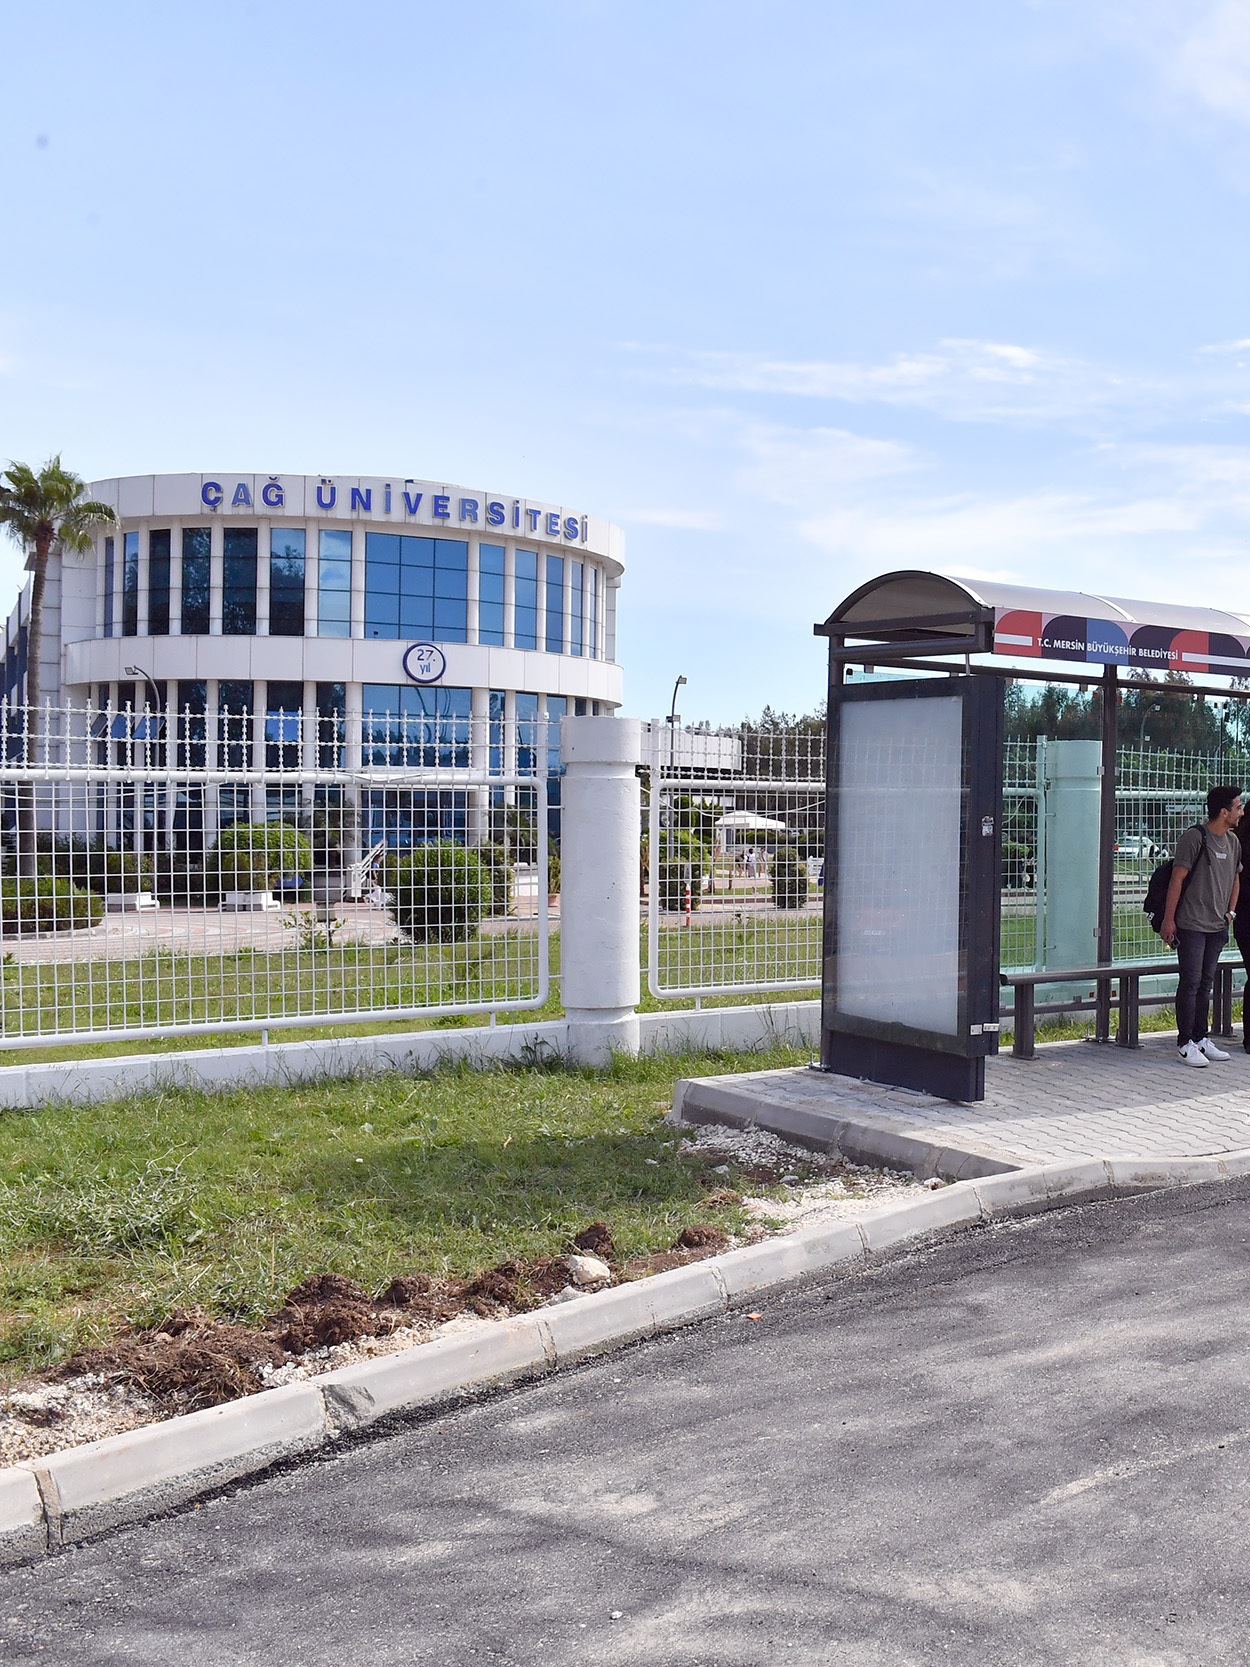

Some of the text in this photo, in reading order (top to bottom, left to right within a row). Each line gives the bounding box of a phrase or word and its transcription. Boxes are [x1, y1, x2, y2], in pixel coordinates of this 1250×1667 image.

[200, 476, 590, 544] ÇAĞ ÜNİVERSİTESİ
[1037, 637, 1179, 660] T.C. MERSİN BÜYÜKŞEHİR BELEDİYESİ
